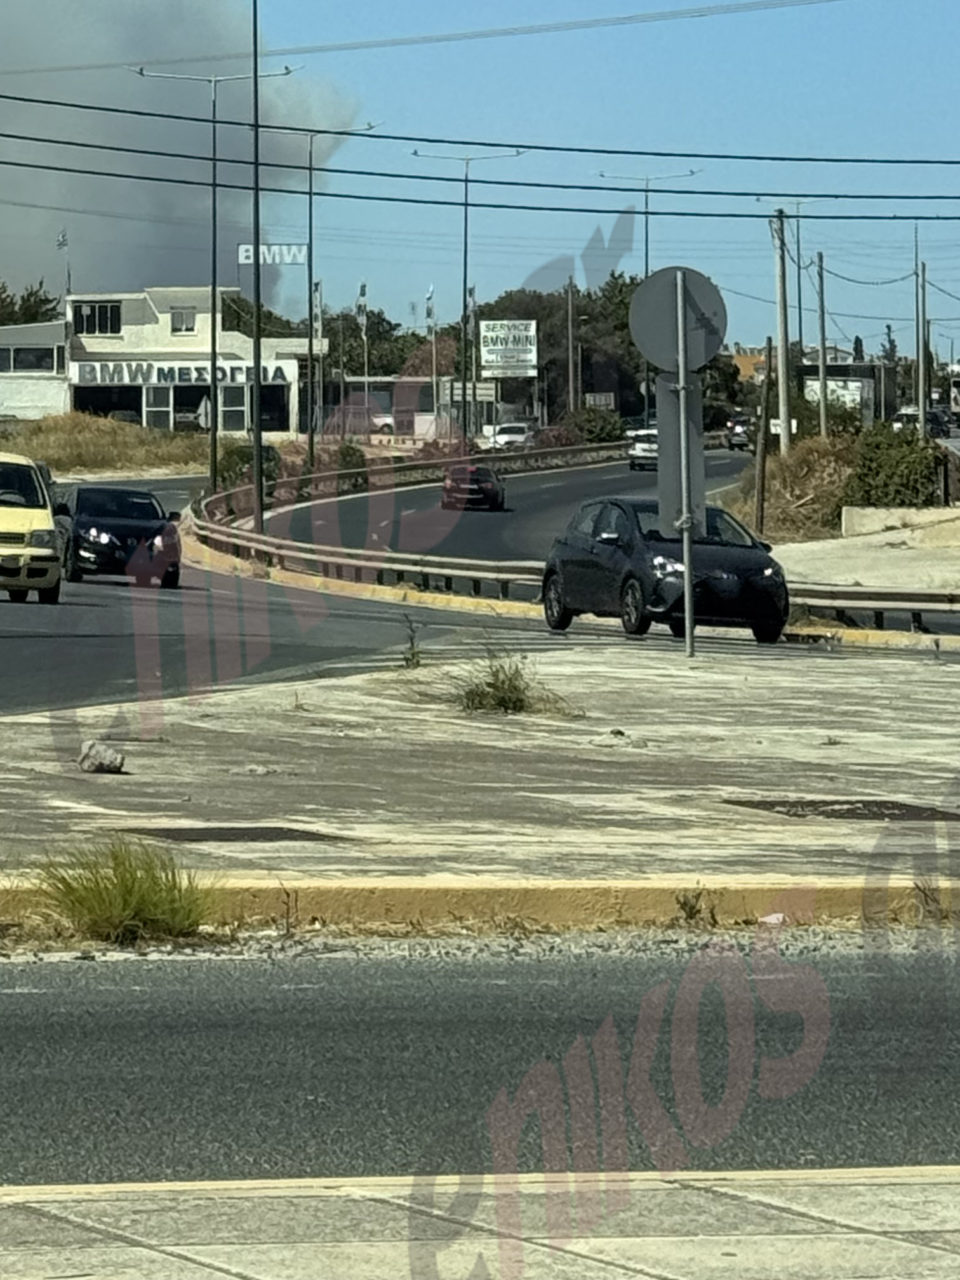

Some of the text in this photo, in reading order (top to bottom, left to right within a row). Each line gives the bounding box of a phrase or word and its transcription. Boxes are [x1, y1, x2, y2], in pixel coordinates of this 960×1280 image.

[238, 244, 308, 264] BMW
[484, 322, 532, 332] SERVICE
[77, 363, 154, 383] BMW
